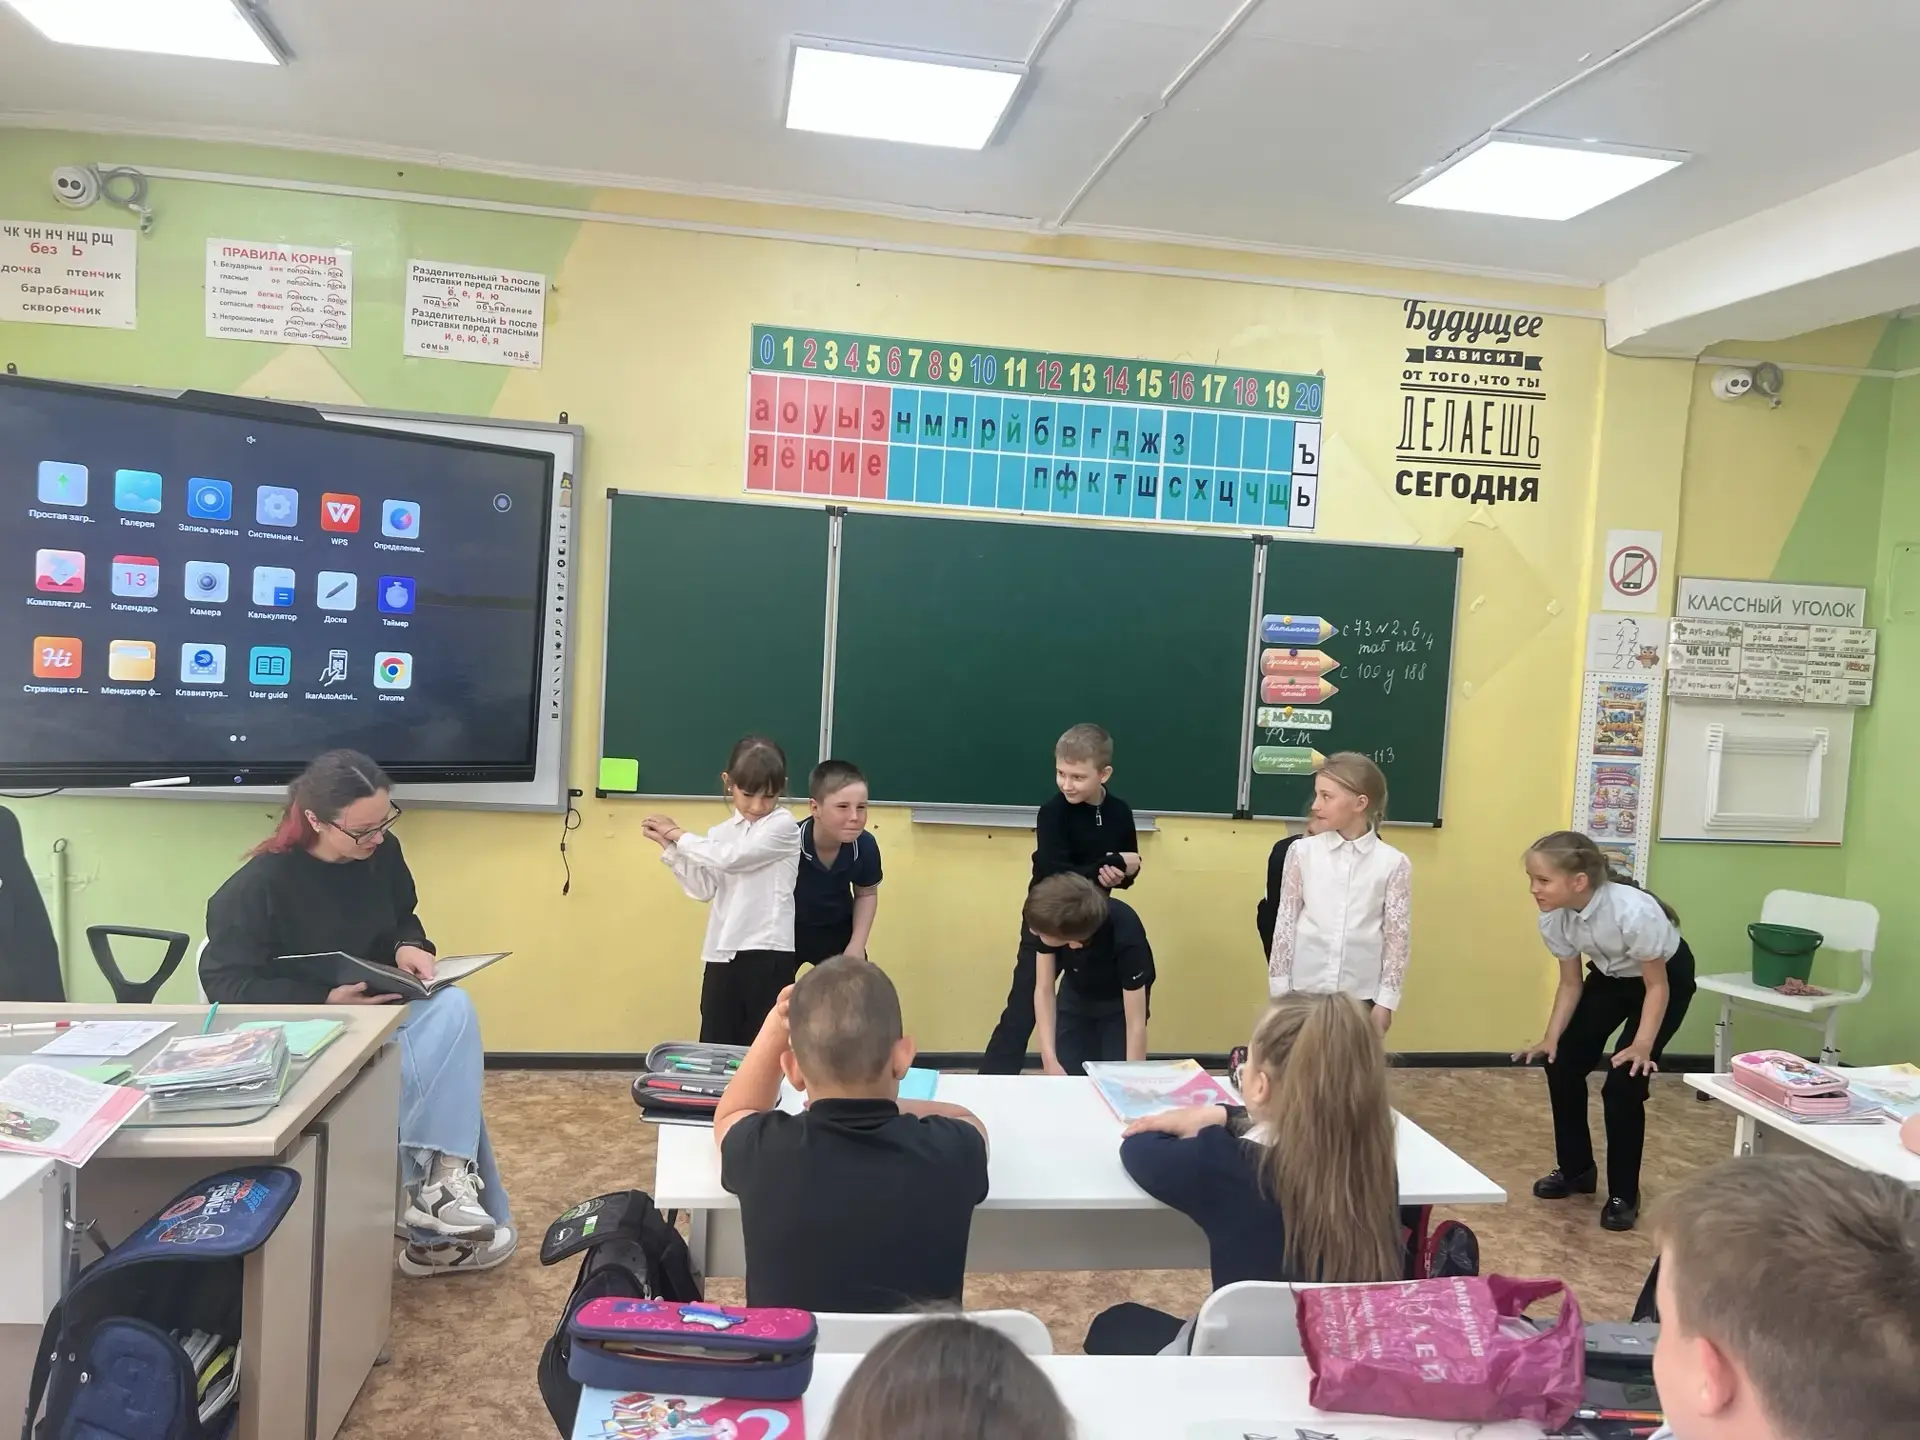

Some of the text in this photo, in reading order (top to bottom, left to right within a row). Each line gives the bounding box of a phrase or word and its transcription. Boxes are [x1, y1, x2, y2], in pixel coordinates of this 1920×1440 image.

[3, 226, 114, 246] чк чн нч нщ рщ
[30, 242, 58, 254] без
[223, 247, 336, 266] ПРАВИЛА КОРНЯ
[0, 264, 122, 279] дочка птенчик
[220, 261, 262, 271] Безударные
[412, 265, 497, 282] Разделительный
[511, 278, 540, 287] после
[412, 274, 540, 294] приставки перед гласными
[20, 283, 104, 298] барабанщик
[220, 287, 247, 295] Парные
[22, 303, 101, 315] скворечник
[220, 300, 254, 309] согласные
[412, 308, 496, 324] Разделительный
[508, 320, 537, 329] после
[1403, 299, 1543, 344] Будущее
[220, 326, 253, 334] согласные
[411, 318, 539, 337] приставки перед гласными
[421, 342, 529, 359] семья копьё
[1434, 349, 1516, 363] ЗАВИСИТ
[760, 334, 1321, 413] 0 1 2 3 4 5 6 7 8 9 10 11 12 13 14 15 16 17 18 19 20
[755, 398, 1315, 465] а о у ы э н м л р й б в г д ж з ъ
[1396, 396, 1540, 458] ДЕЛАЕШЬ
[752, 439, 1310, 511] я ё ю и е п ф к т ш с х ц ч щ ь
[1395, 470, 1539, 505] СЕГОДНЯ
[29, 509, 68, 520] Простая
[120, 518, 155, 529] Галерея
[178, 523, 239, 536] Запись экрана
[247, 530, 292, 541] Системные
[330, 537, 348, 546] WPS
[125, 572, 146, 587] 13
[26, 597, 72, 607] Комплект
[110, 602, 158, 613] Календарь
[1688, 594, 1855, 618] КЛАССНЫЙ УГОЛОК
[190, 607, 221, 617] Камера
[248, 610, 297, 622] Калькулятор
[323, 615, 347, 624] Доска
[382, 618, 409, 628] Таймер
[1395, 640, 1417, 652] на
[1686, 646, 1731, 657] ЧК ЧН ЧТ
[1267, 655, 1299, 668] Русский
[1404, 662, 1427, 681] 188
[23, 684, 68, 694] Страница
[101, 686, 147, 696] Менеджер
[267, 691, 288, 700] guide
[378, 694, 405, 702] Chrome
[1272, 711, 1331, 724] МУЗЫКА
